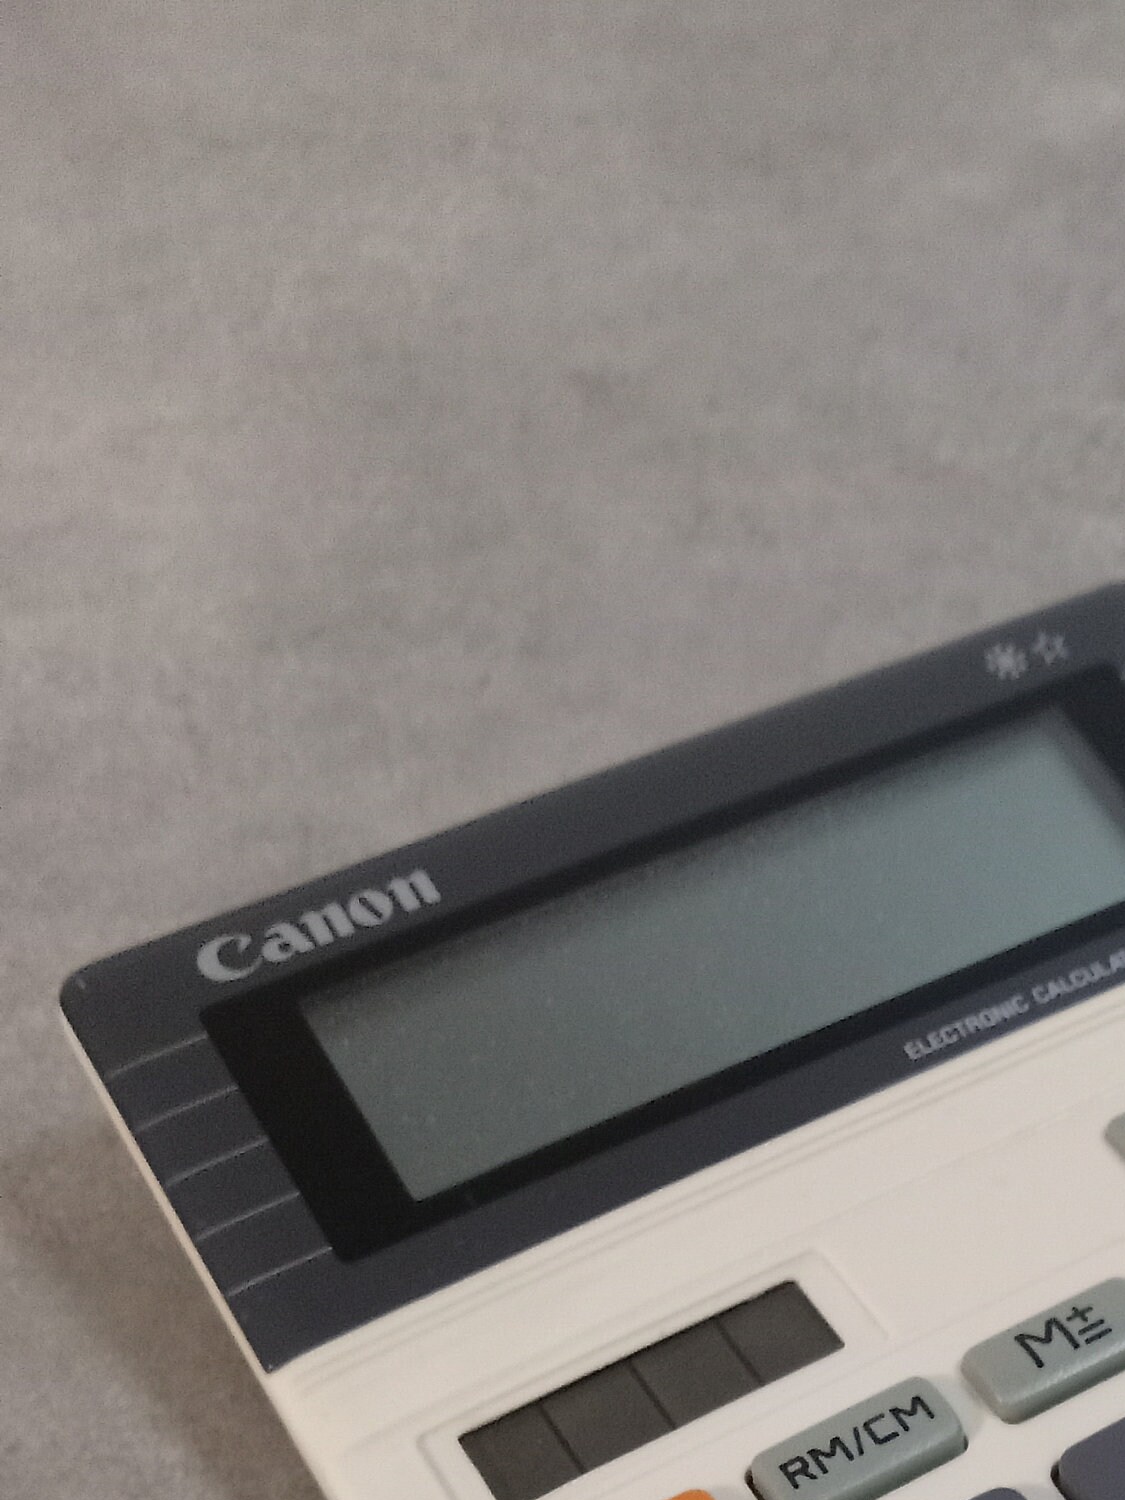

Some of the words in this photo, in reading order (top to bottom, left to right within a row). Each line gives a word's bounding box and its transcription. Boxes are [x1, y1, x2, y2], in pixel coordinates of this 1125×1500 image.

[196, 869, 442, 982] Canon
[903, 995, 1029, 1060] ELECTRONIC
[778, 1394, 936, 1490] RM/CM
